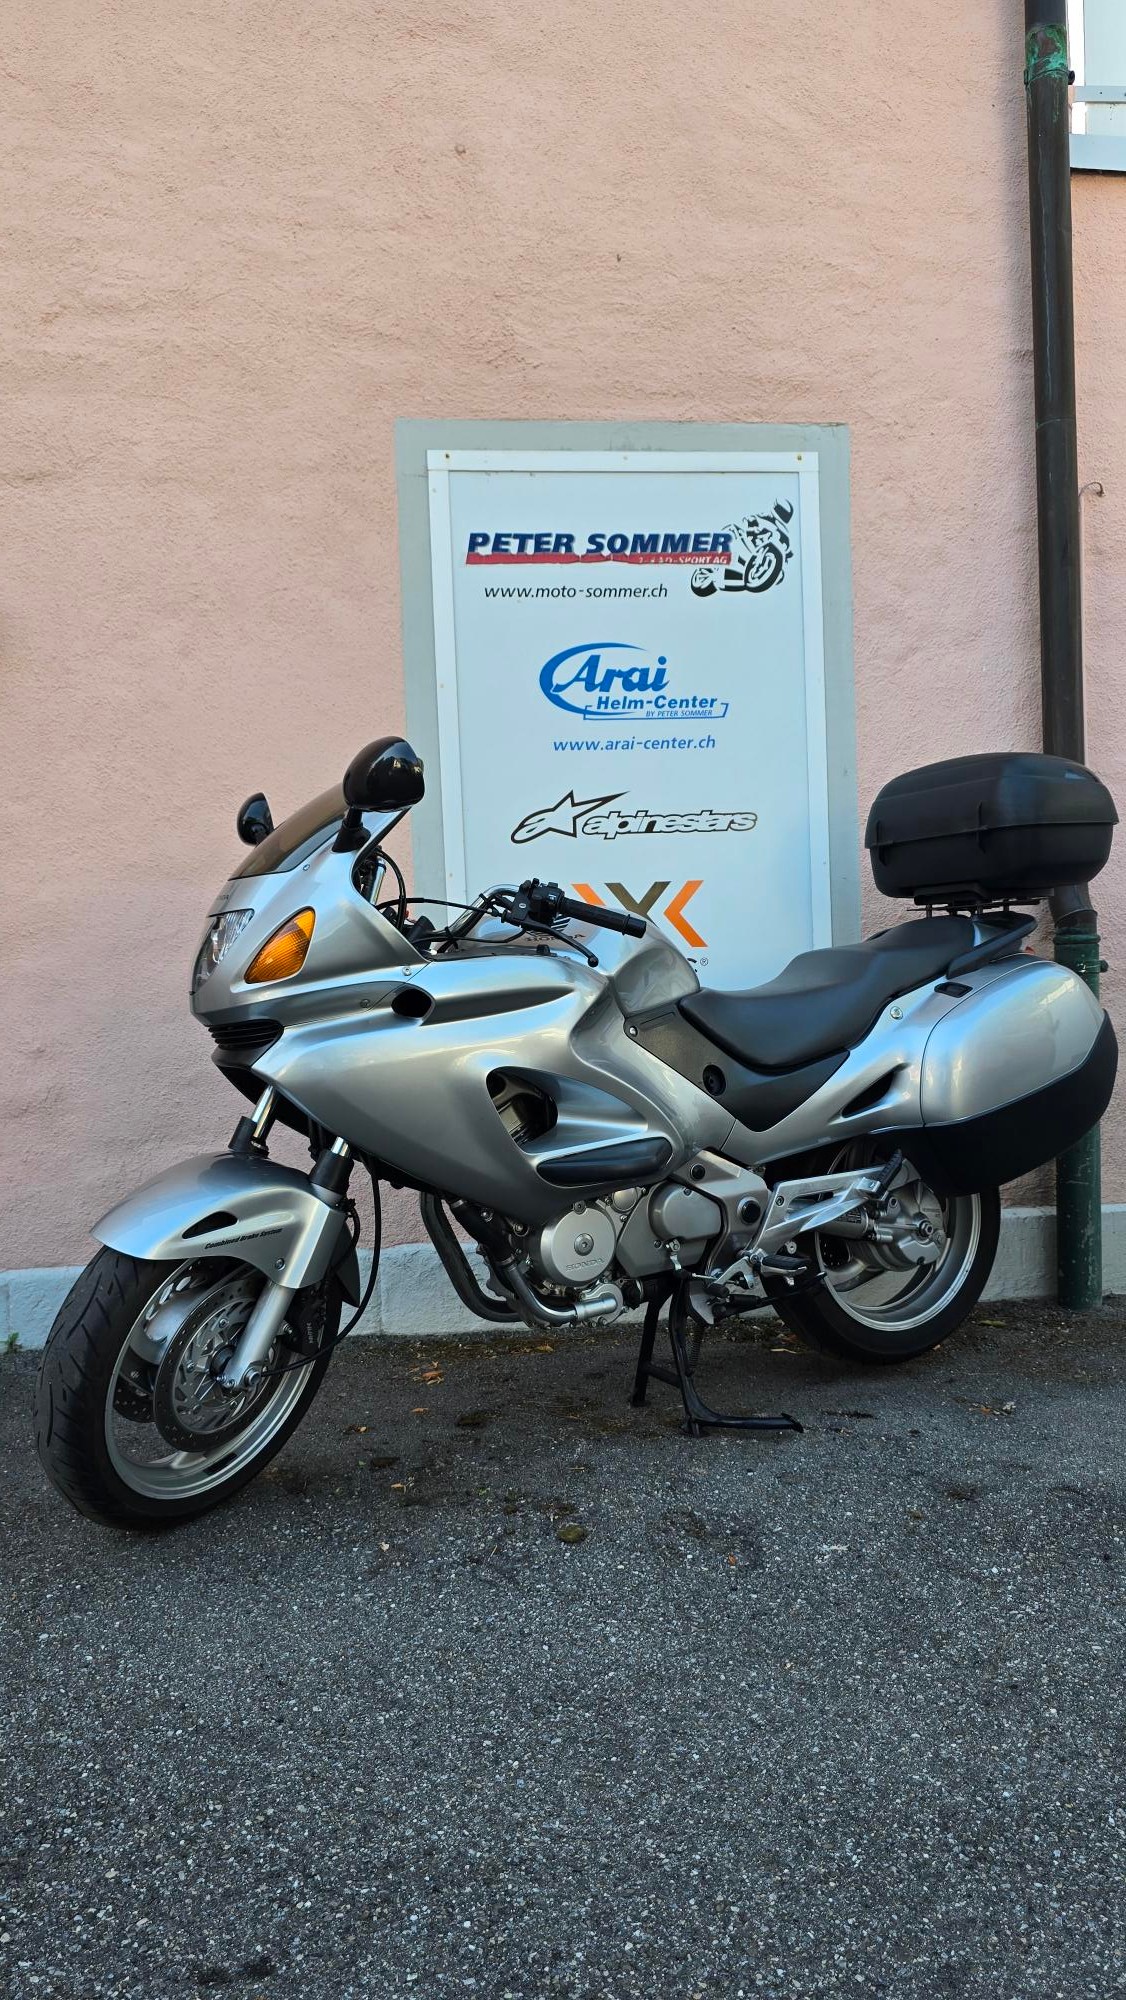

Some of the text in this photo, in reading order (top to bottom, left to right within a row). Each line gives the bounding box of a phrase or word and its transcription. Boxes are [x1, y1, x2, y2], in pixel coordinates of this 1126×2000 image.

[468, 532, 733, 554] PETER SOMMER
[713, 555, 728, 564] AG
[484, 583, 668, 598] www.moto-sommer.ch
[551, 654, 670, 693] Arai
[596, 694, 718, 710] Helm-Center
[646, 710, 656, 718] BY
[681, 709, 713, 717] SOMMER
[553, 734, 716, 751] www.arai-center.ch
[582, 810, 757, 840] alpinestars
[565, 1257, 605, 1271] HONDA
